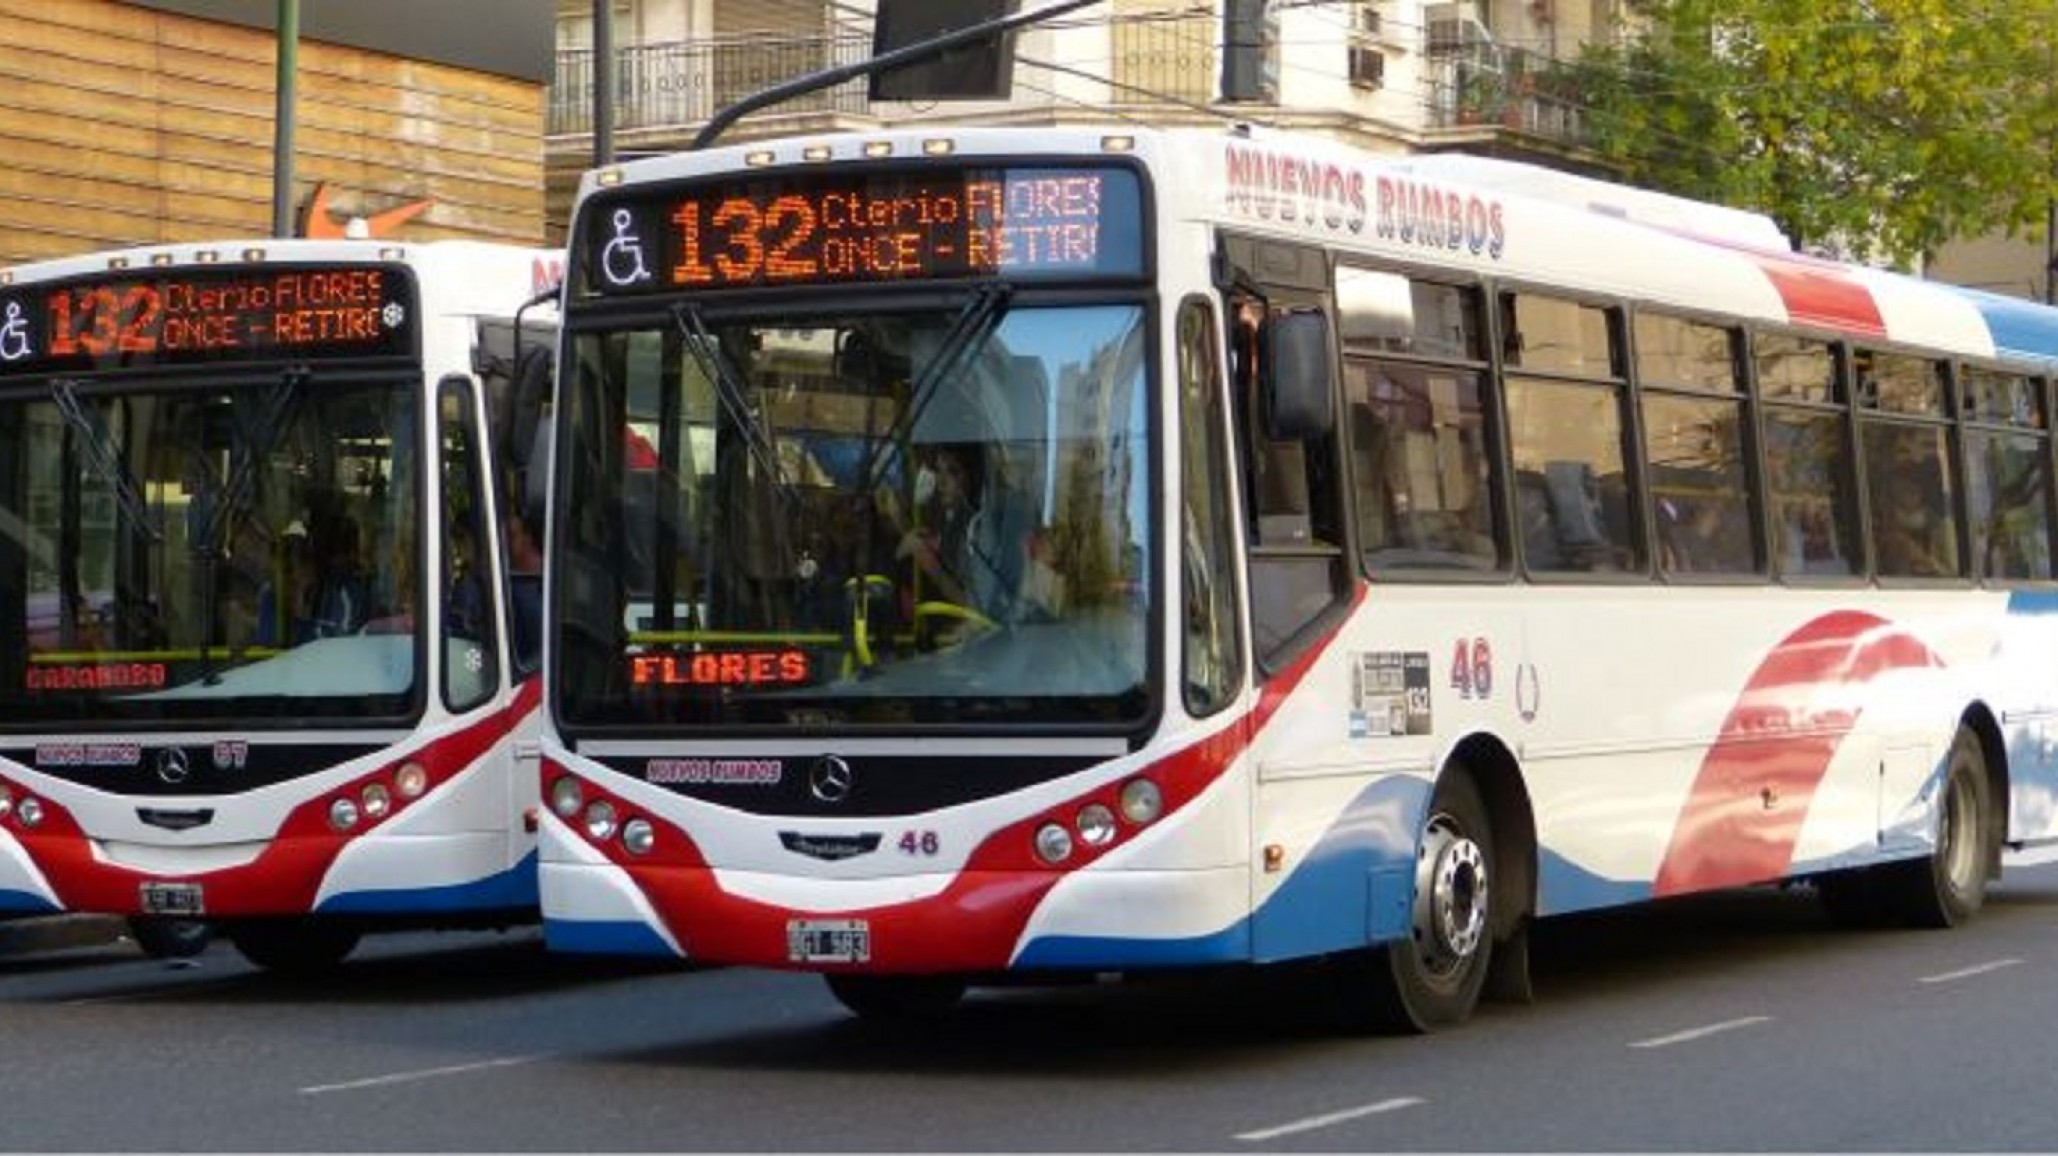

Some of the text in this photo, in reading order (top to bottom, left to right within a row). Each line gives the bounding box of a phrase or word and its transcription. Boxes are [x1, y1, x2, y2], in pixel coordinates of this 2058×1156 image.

[821, 190, 959, 230] Cterio
[1226, 143, 1506, 260] NUEVOS RUMBOS
[671, 194, 818, 285] 132
[823, 233, 922, 275] ONCE
[968, 223, 1098, 268] RETIR
[48, 285, 161, 356] 132
[164, 284, 270, 313] Cterio
[163, 315, 239, 349] ONCE
[633, 651, 807, 684] FLORES
[1451, 637, 1491, 699] 46
[898, 830, 938, 855] 46
